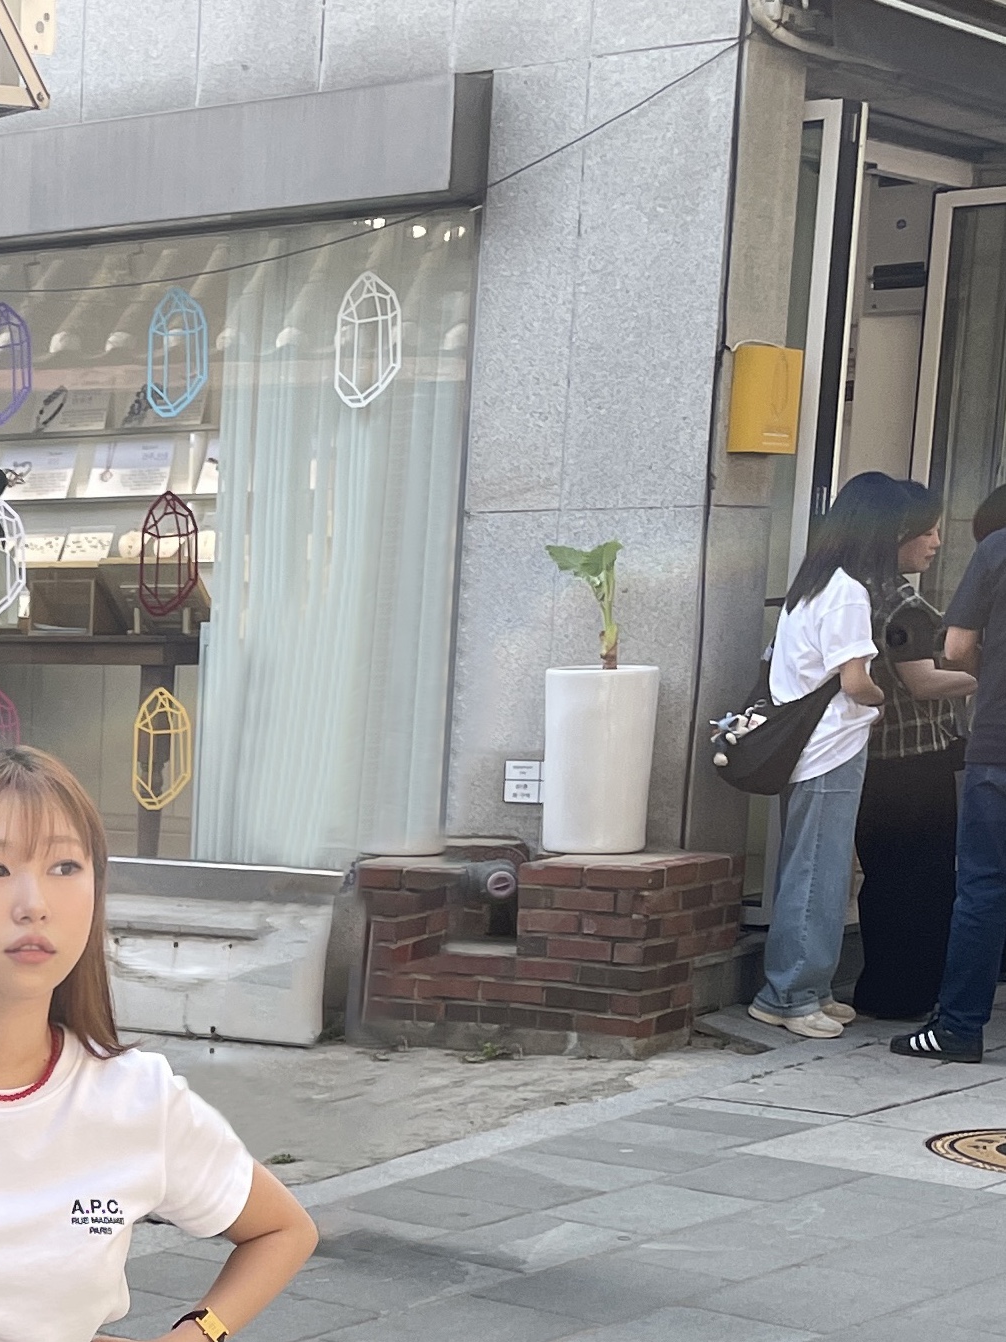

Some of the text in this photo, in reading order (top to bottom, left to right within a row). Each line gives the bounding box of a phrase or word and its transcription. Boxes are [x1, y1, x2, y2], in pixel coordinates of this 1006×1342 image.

[71, 1199, 124, 1215] A.P.C.
[71, 1217, 90, 1225] RUE
[89, 1227, 113, 1235] PARIS
